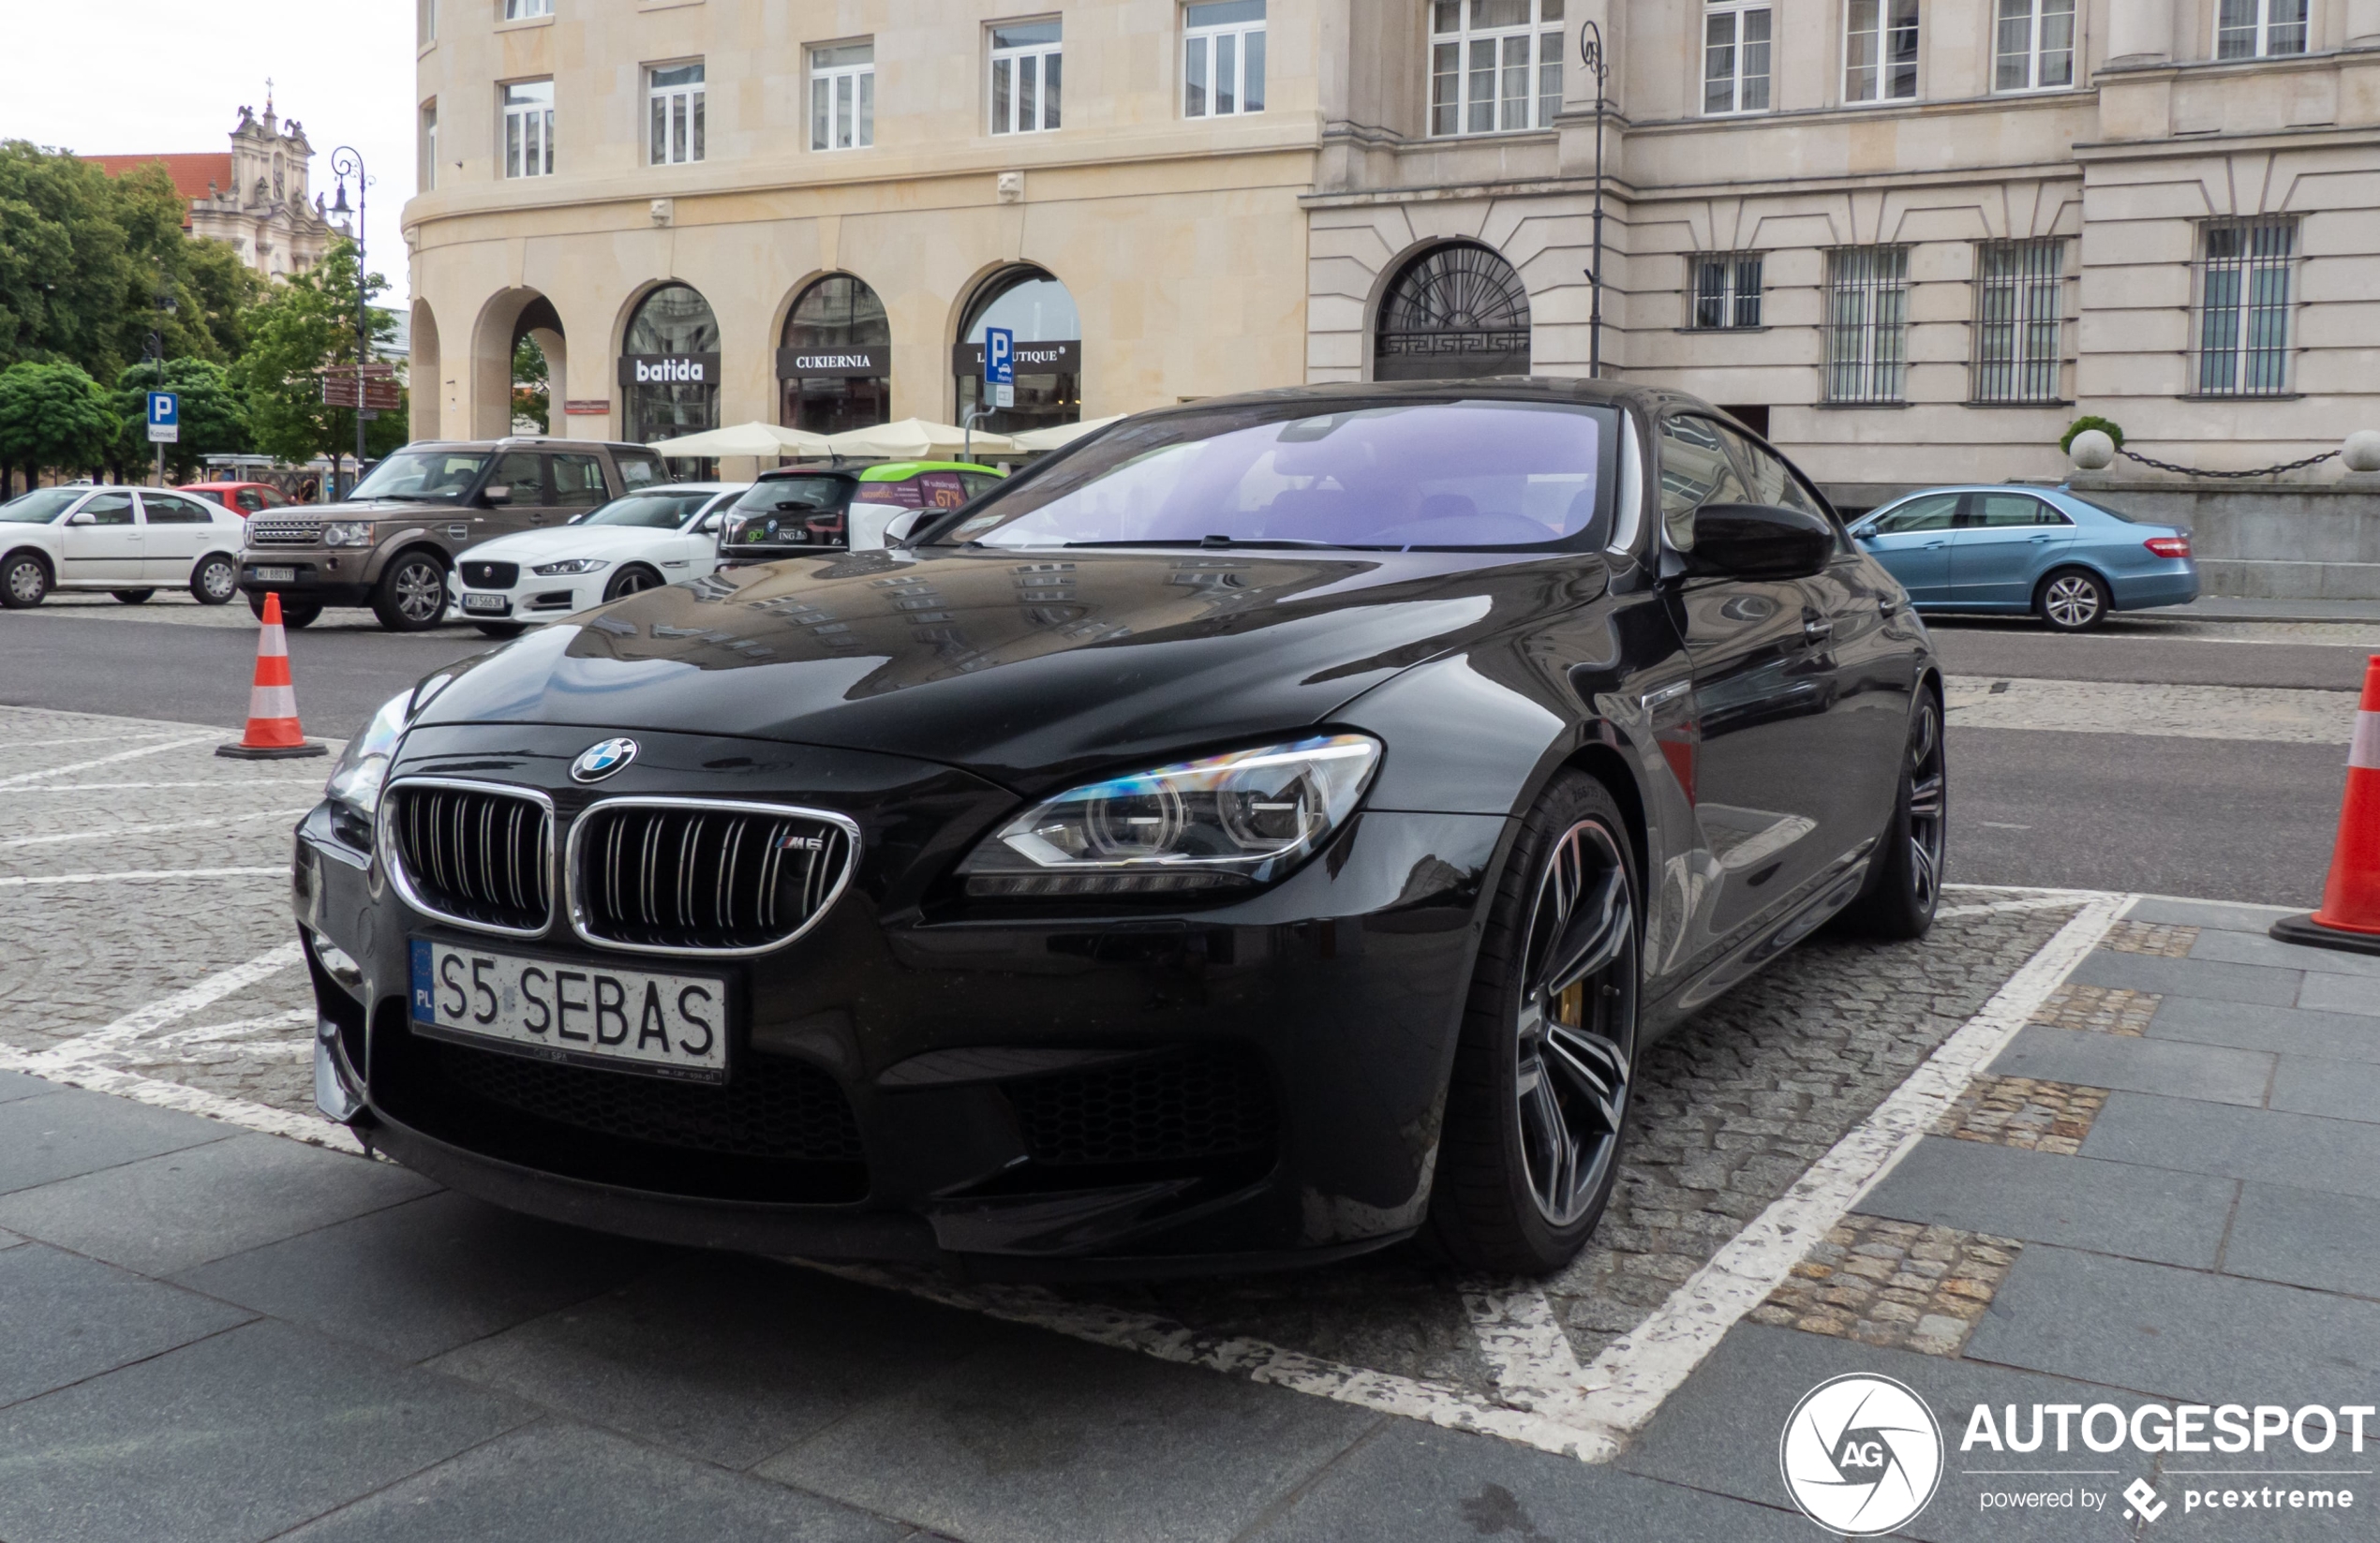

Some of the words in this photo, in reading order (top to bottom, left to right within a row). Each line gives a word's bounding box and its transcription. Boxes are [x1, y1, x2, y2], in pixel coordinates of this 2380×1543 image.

[992, 332, 1008, 367] P
[636, 359, 704, 381] batida
[796, 355, 871, 368] CUKIERNIA
[155, 395, 172, 422] P
[779, 531, 796, 541] ING
[416, 989, 432, 1009] PL
[441, 954, 498, 1025] S5
[520, 967, 713, 1056] SEBAS
